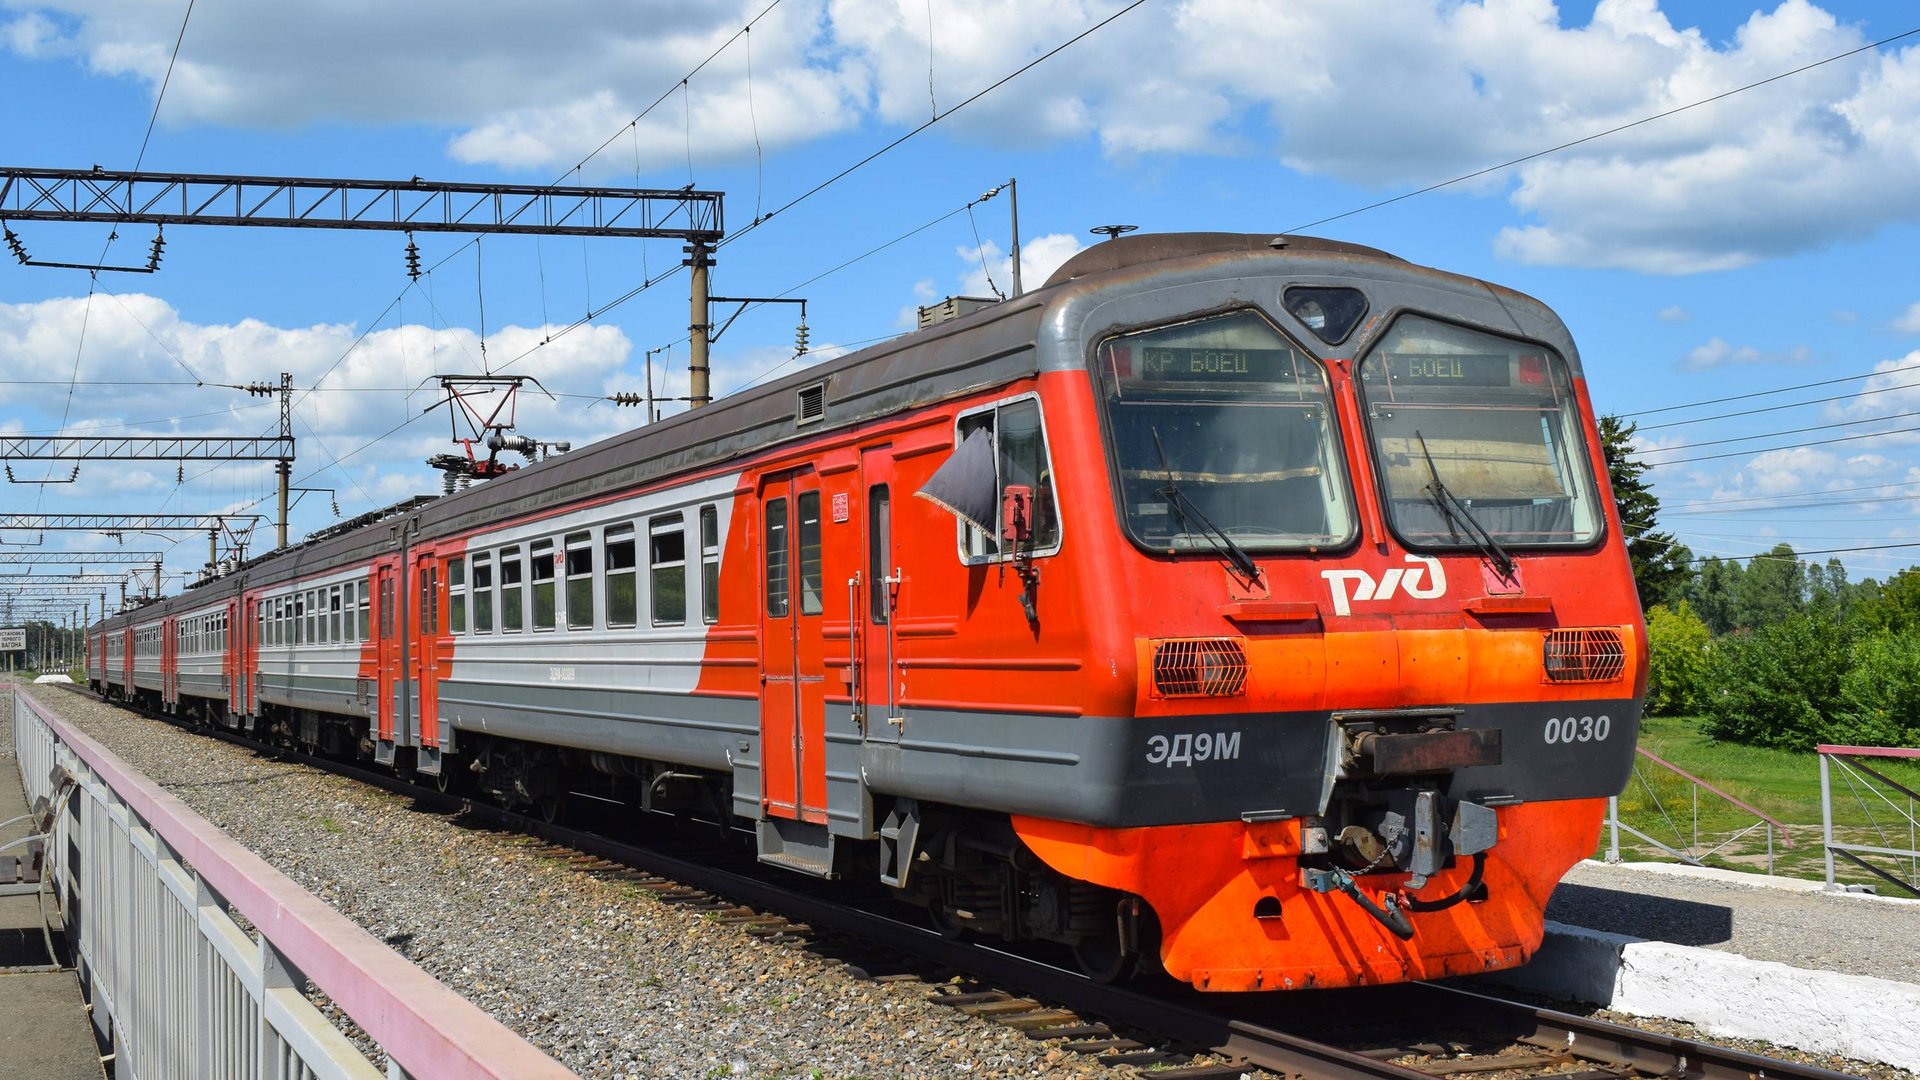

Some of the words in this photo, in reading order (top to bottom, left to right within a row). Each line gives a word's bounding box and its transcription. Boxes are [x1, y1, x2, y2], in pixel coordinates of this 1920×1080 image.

[1144, 351, 1174, 372] КР
[1190, 351, 1248, 373] БОЕЦ
[1409, 357, 1463, 378] БОЕЦ
[1321, 554, 1447, 616] РЖД
[1544, 715, 1611, 745] 0030
[1145, 731, 1241, 768] ЭД9М
